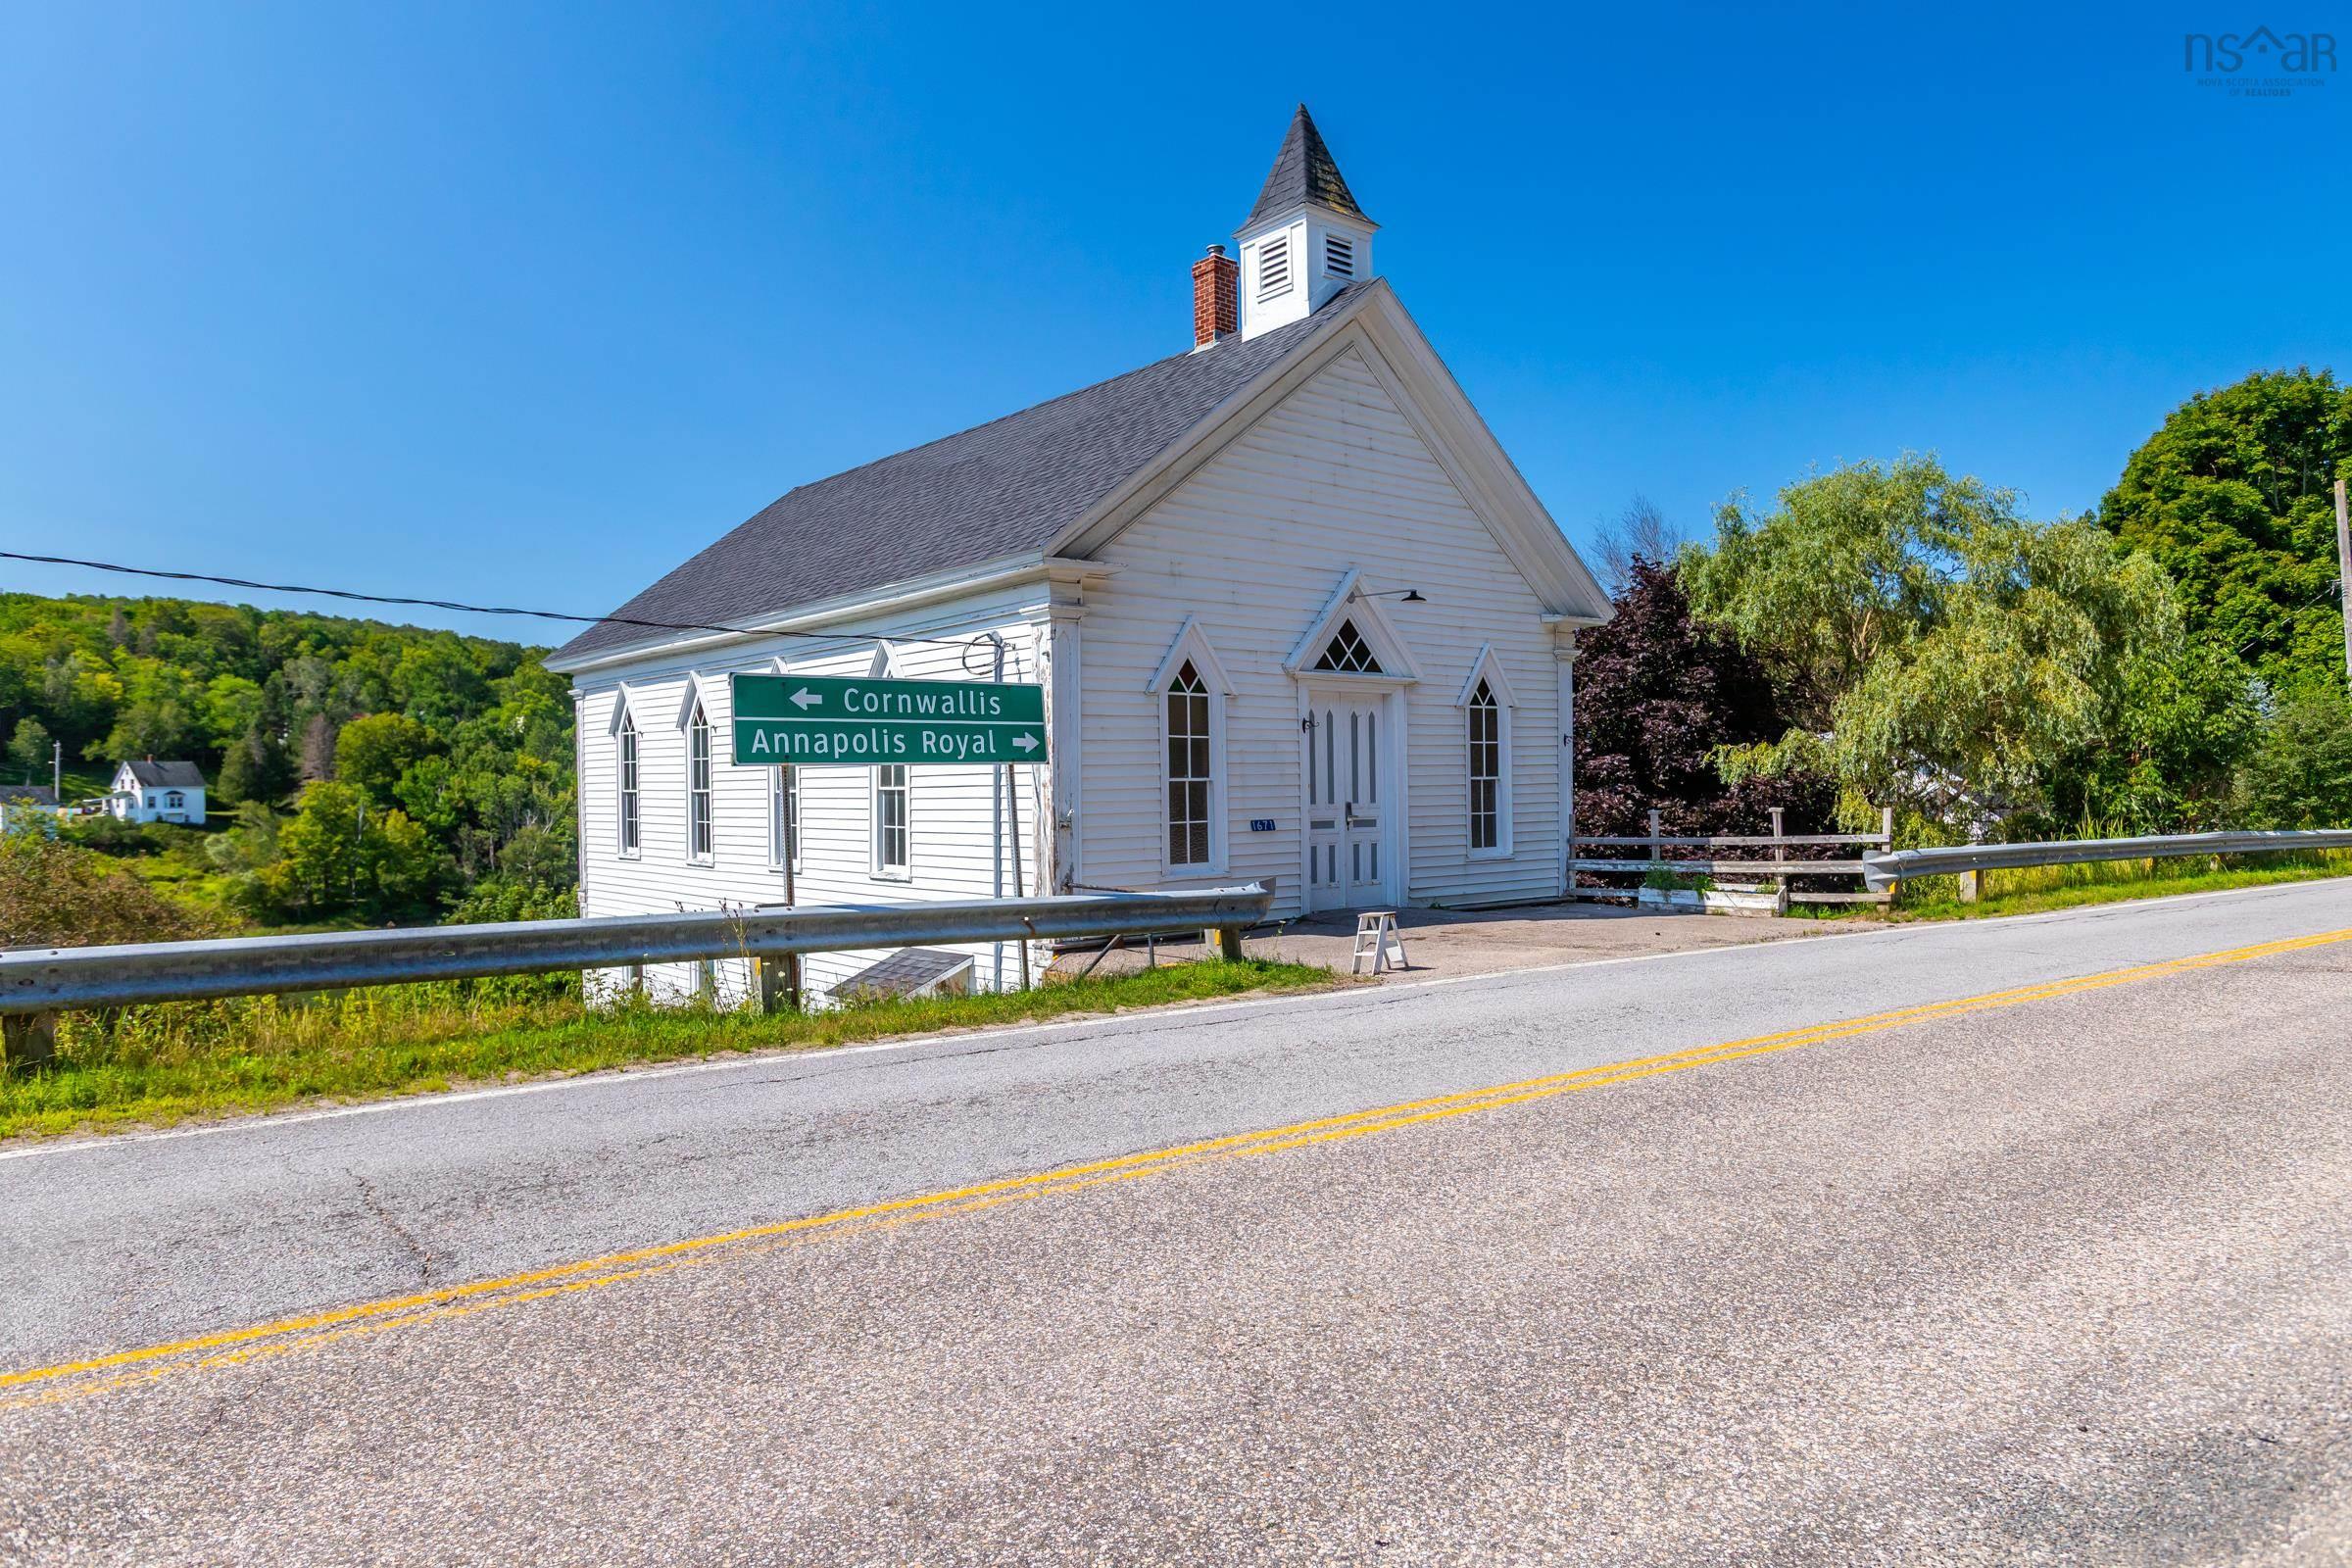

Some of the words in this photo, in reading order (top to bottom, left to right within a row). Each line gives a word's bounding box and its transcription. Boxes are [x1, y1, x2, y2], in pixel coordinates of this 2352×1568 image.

[844, 688, 1001, 714] Cornwallis
[751, 728, 906, 759] Annapolis
[922, 730, 996, 760] Royal
[1252, 820, 1274, 831] 1671
